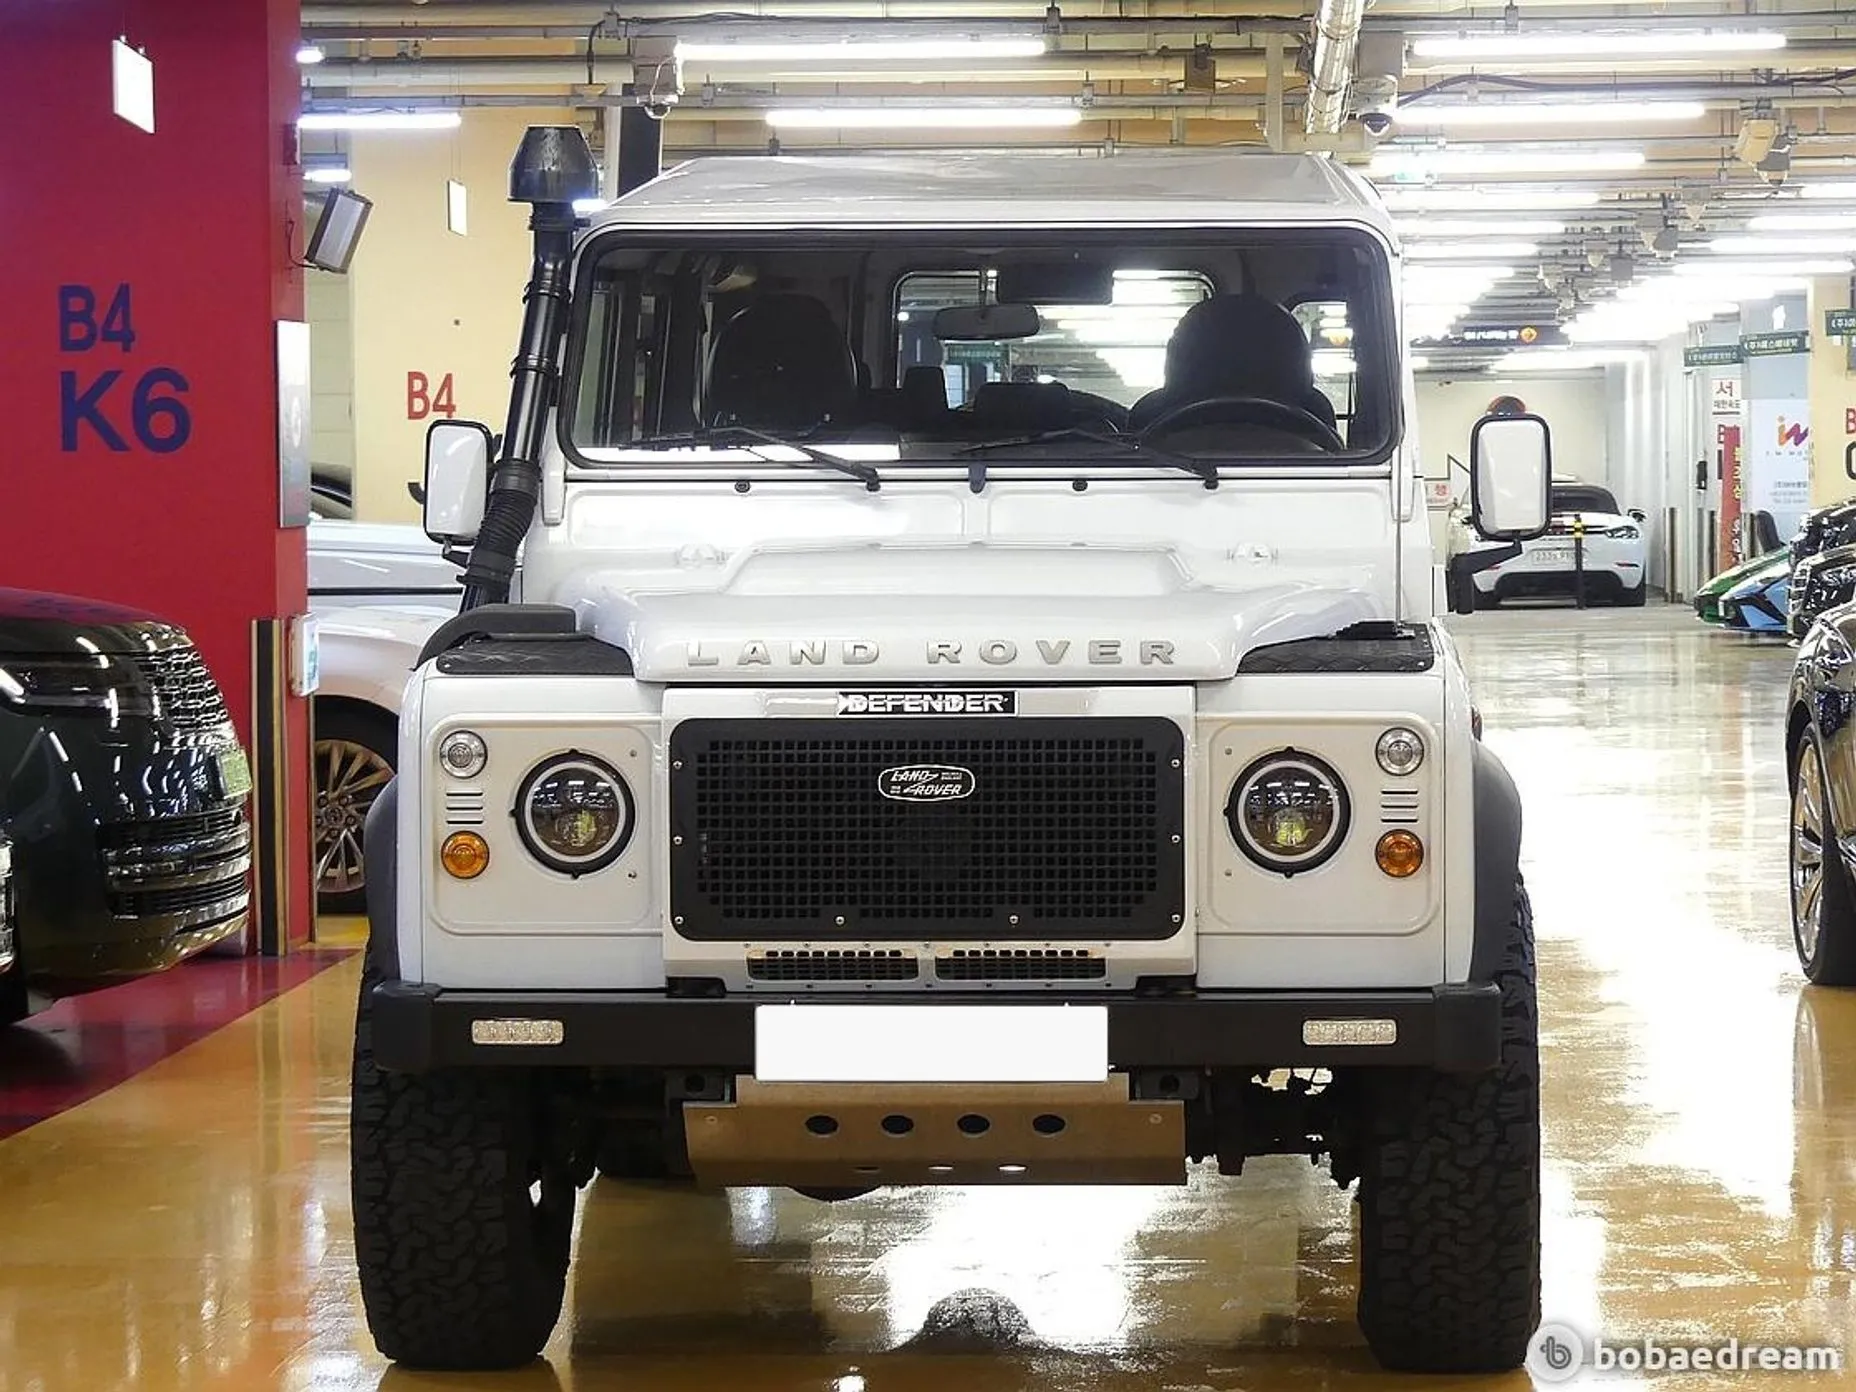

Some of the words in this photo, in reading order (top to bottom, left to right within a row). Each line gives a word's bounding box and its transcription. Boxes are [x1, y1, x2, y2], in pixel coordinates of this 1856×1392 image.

[58, 283, 136, 353] B4
[60, 367, 192, 454] K6
[407, 371, 457, 421] B4
[686, 639, 881, 667] LAND
[926, 638, 1177, 666] ROVER
[846, 692, 1004, 713] DEFENDER
[889, 770, 931, 782] LAND
[913, 783, 963, 796] ROVER
